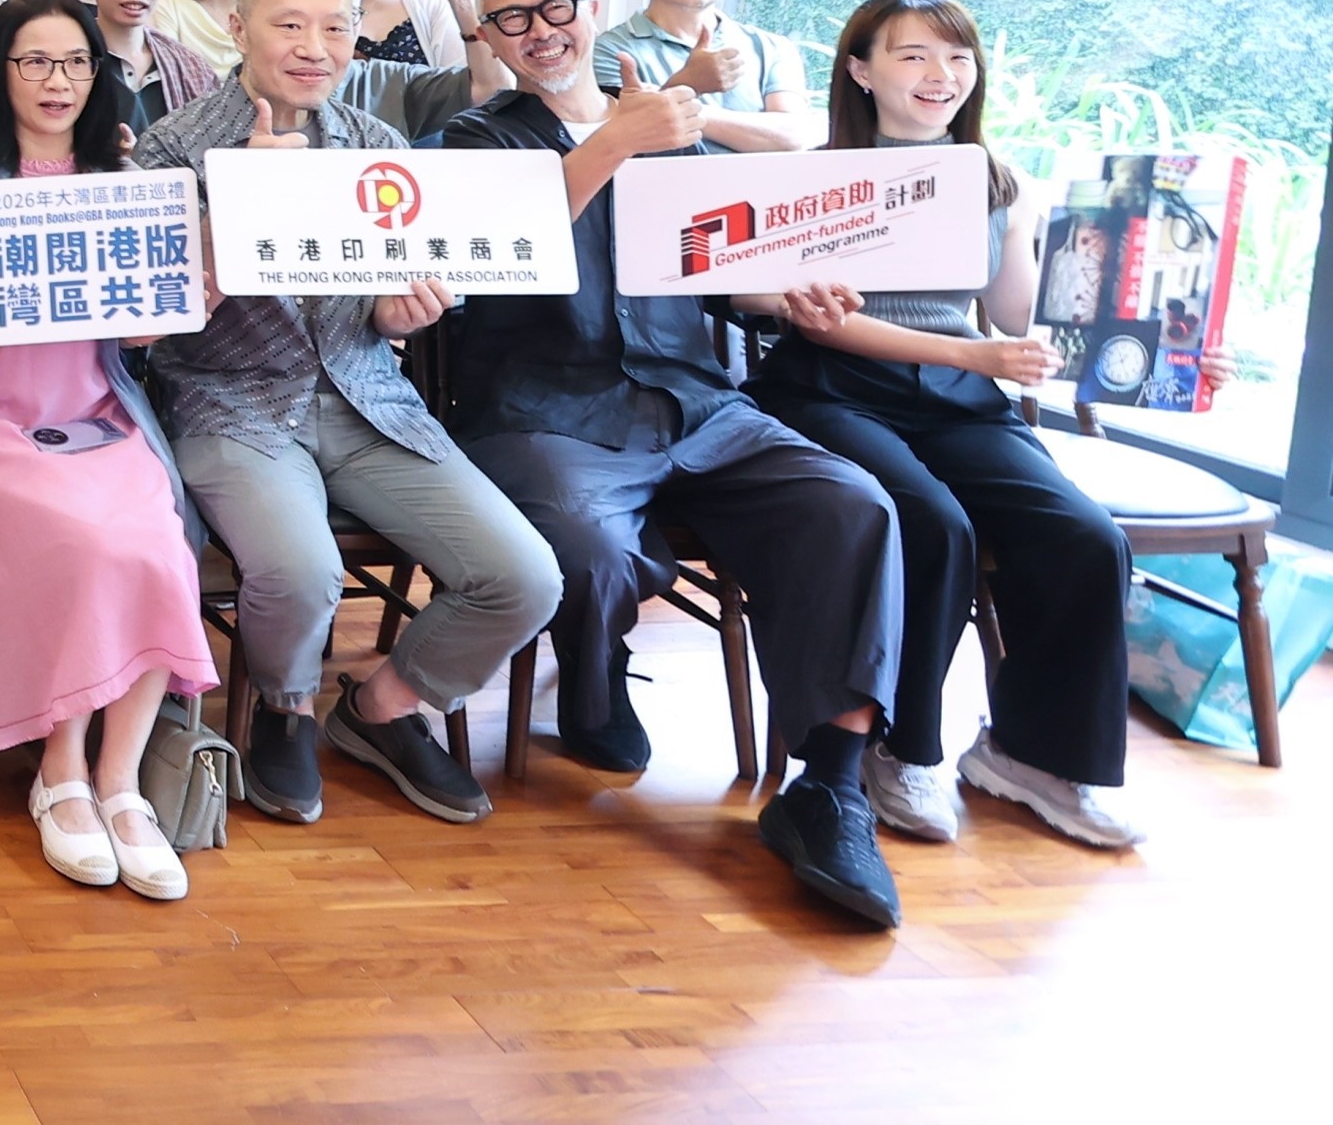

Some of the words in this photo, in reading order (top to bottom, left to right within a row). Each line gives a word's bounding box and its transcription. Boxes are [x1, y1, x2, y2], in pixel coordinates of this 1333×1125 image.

[20, 214, 43, 226] Kong
[46, 210, 103, 224] Books@GBA
[106, 206, 160, 220] Bookstores
[163, 204, 187, 217] 2026
[765, 179, 875, 230] 政府資助
[885, 176, 935, 210] 計劃
[255, 237, 533, 262] 香港印刷業商會
[715, 211, 875, 266] Government-funded
[801, 225, 890, 260] programme
[258, 271, 285, 283] THE
[288, 271, 329, 283] HONG
[333, 271, 373, 283] KONG
[377, 271, 442, 283] PRINTERS
[446, 270, 538, 283] ASSOCIATION
